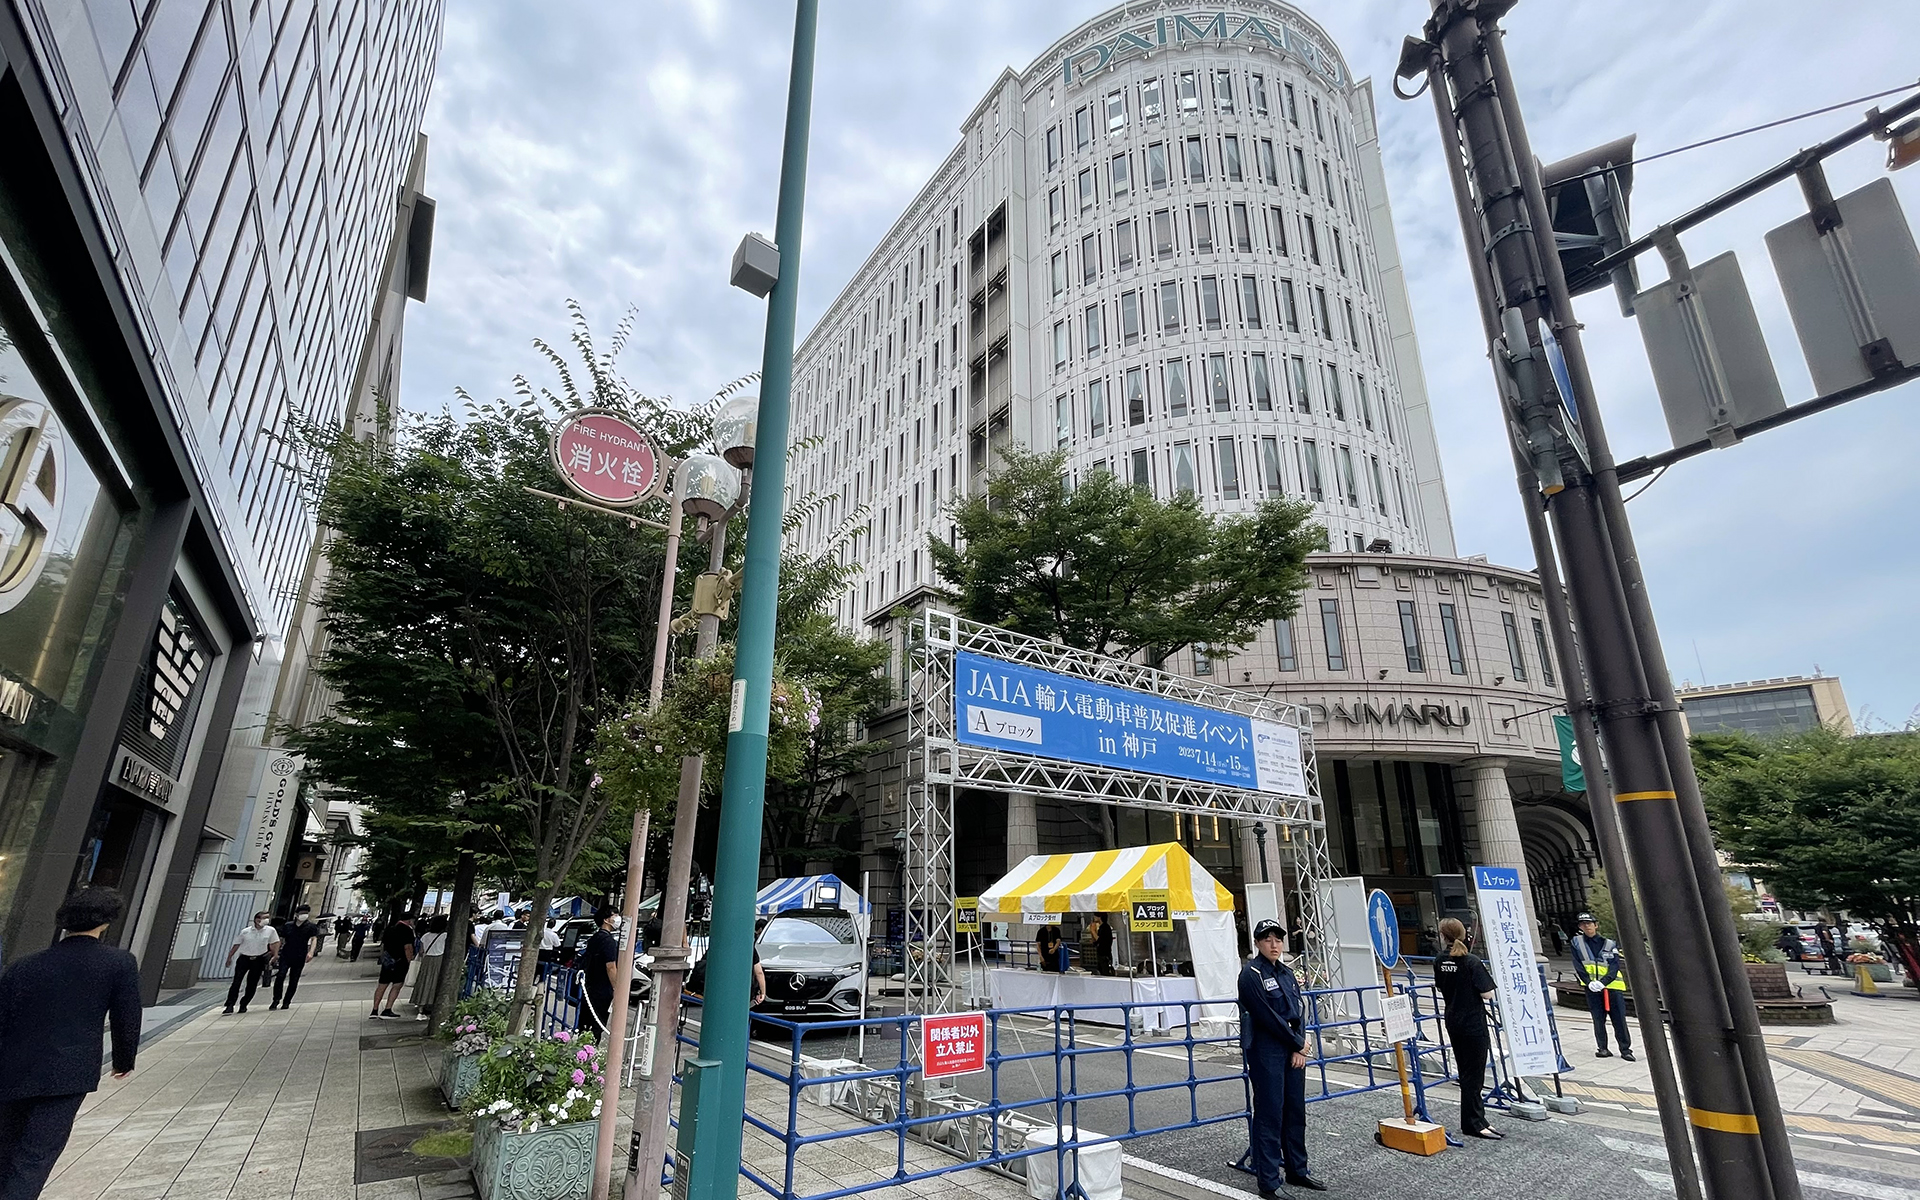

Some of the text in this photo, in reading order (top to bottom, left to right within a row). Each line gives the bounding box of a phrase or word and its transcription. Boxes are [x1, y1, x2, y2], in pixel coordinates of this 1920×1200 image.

[573, 424, 646, 453] FIRE HYDRANT
[568, 442, 644, 486] 消火栓
[967, 668, 1248, 750] JAIA 輸入電動車普及促進イベント
[974, 710, 1034, 738] A ブロック
[1098, 729, 1158, 759] in 神戸
[1178, 746, 1195, 758] 2023
[269, 778, 287, 828] GOLD'S
[256, 792, 274, 848] FITNESS CLUB
[260, 831, 274, 863] GYM
[1483, 871, 1515, 886] Aブロック
[1496, 896, 1538, 1046] 内覧会場入口
[930, 1024, 980, 1042] 関係者以外
[936, 1040, 975, 1057] 立入禁止
